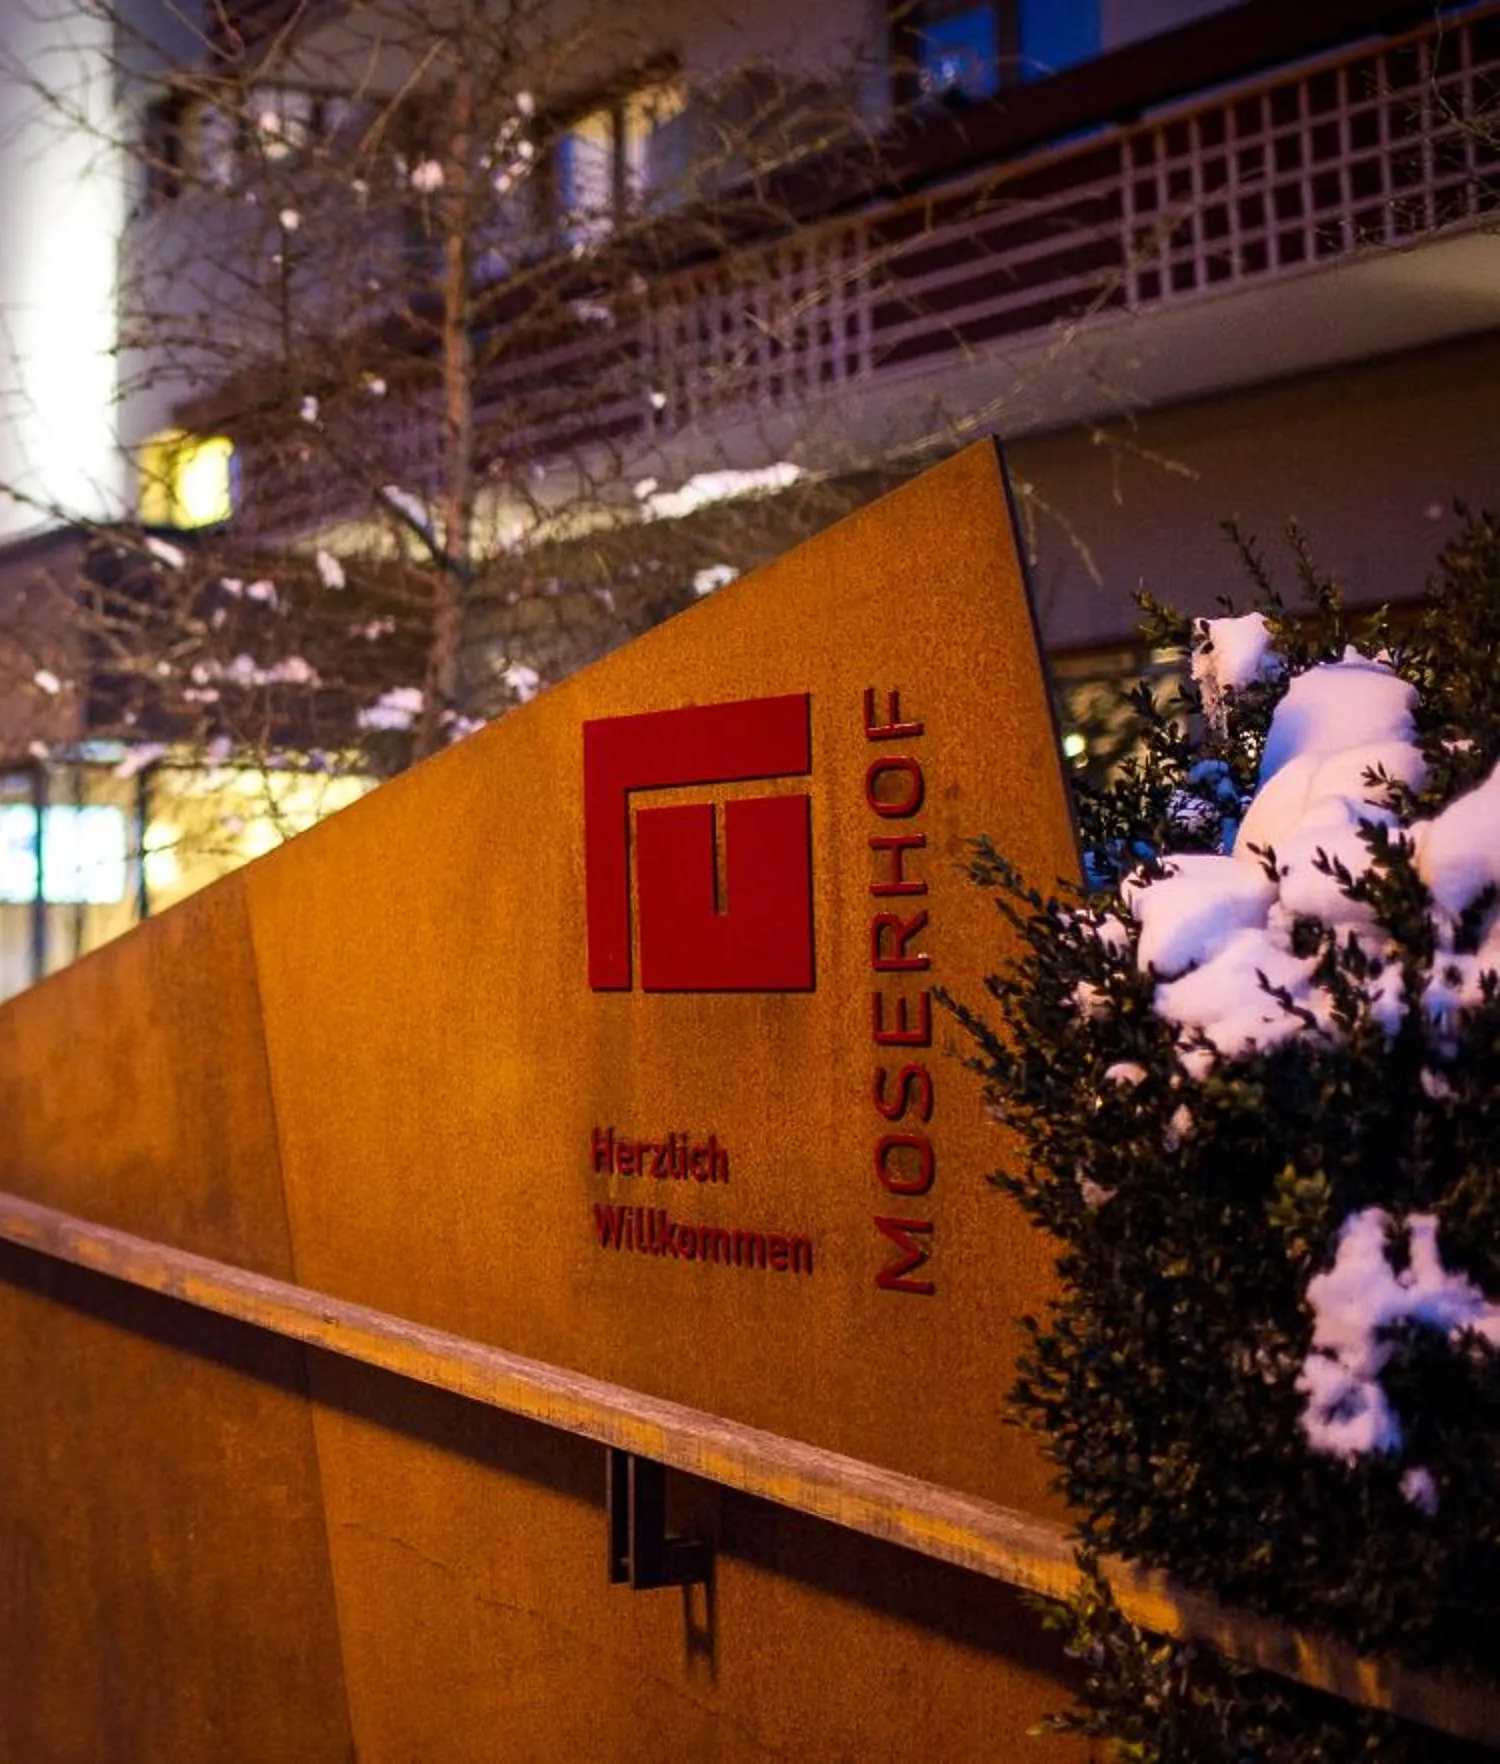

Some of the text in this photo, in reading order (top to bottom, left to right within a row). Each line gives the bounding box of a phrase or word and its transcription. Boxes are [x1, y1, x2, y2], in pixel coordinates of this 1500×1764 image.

[864, 687, 935, 1294] MOSERHOF
[591, 1127, 729, 1183] Herzlich
[595, 1204, 814, 1274] Willkommen
